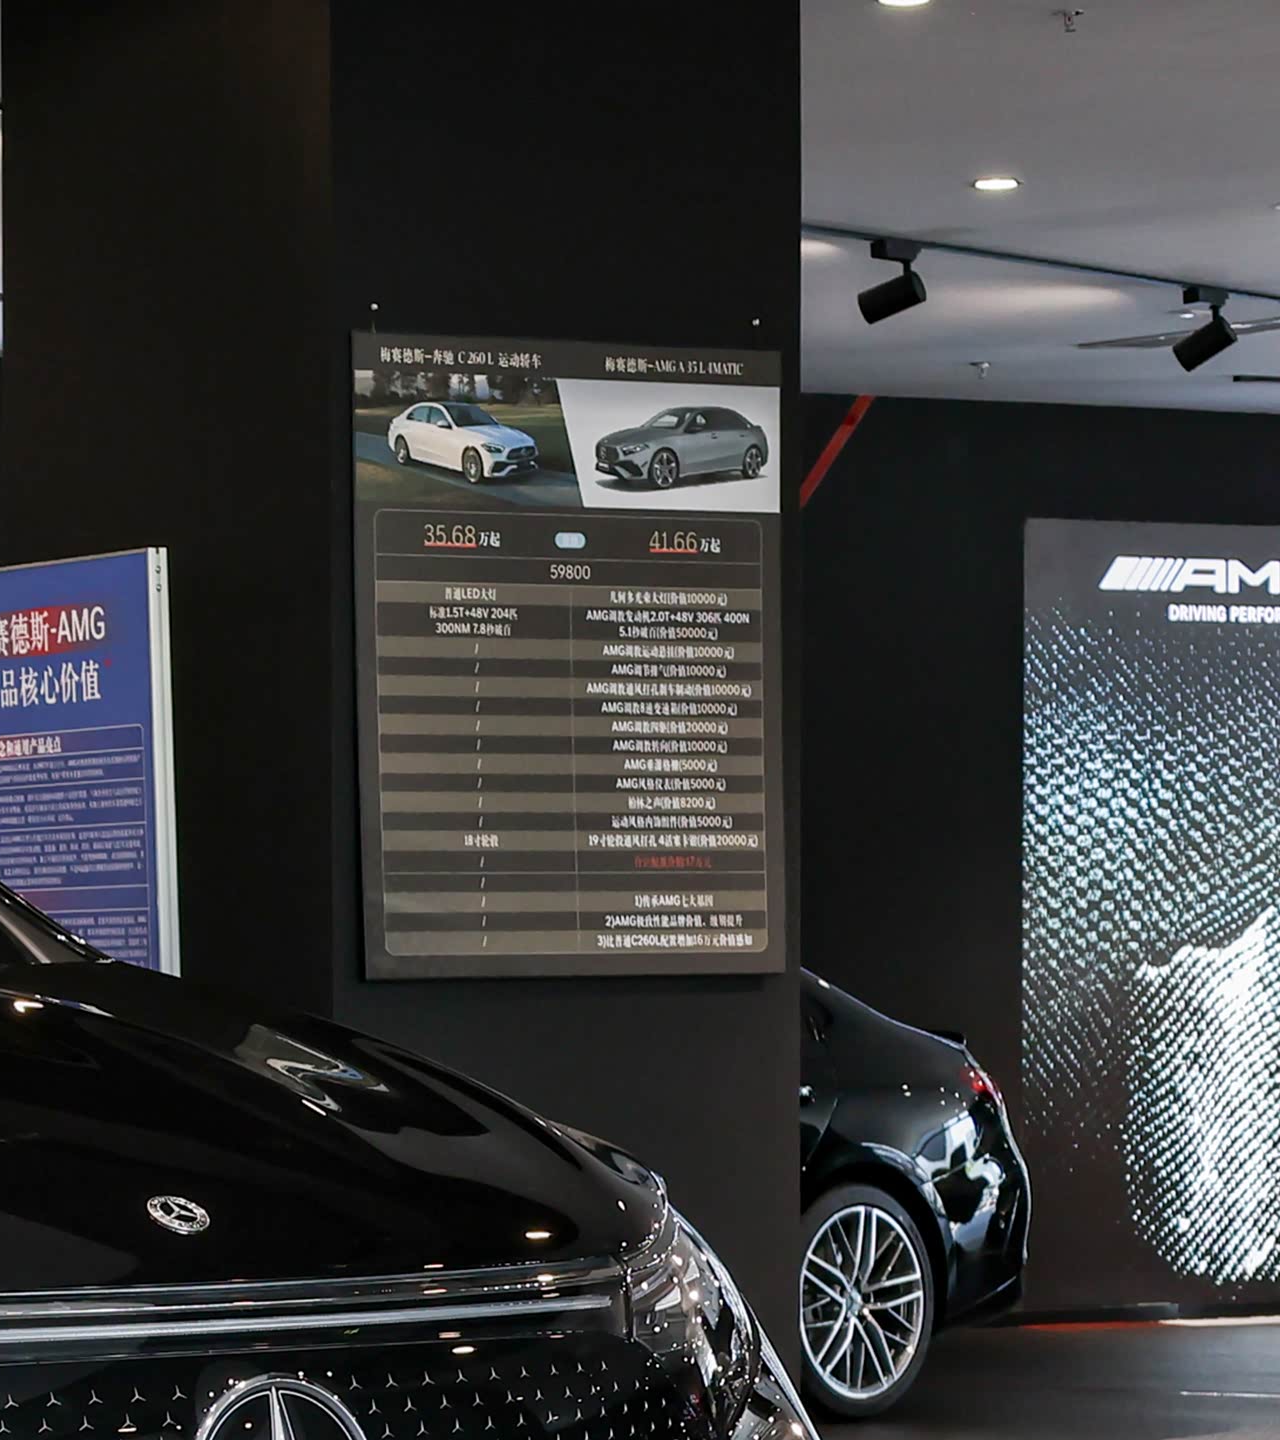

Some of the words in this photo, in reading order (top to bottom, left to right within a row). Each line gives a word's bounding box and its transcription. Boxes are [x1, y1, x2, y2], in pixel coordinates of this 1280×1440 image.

[498, 353, 542, 369] 运动轿车
[605, 356, 676, 374] 梅赛德斯-AMG
[549, 564, 591, 580] 59800
[724, 612, 750, 624] 400N
[1167, 603, 1227, 623] DRIVING
[435, 622, 471, 634] 300NM
